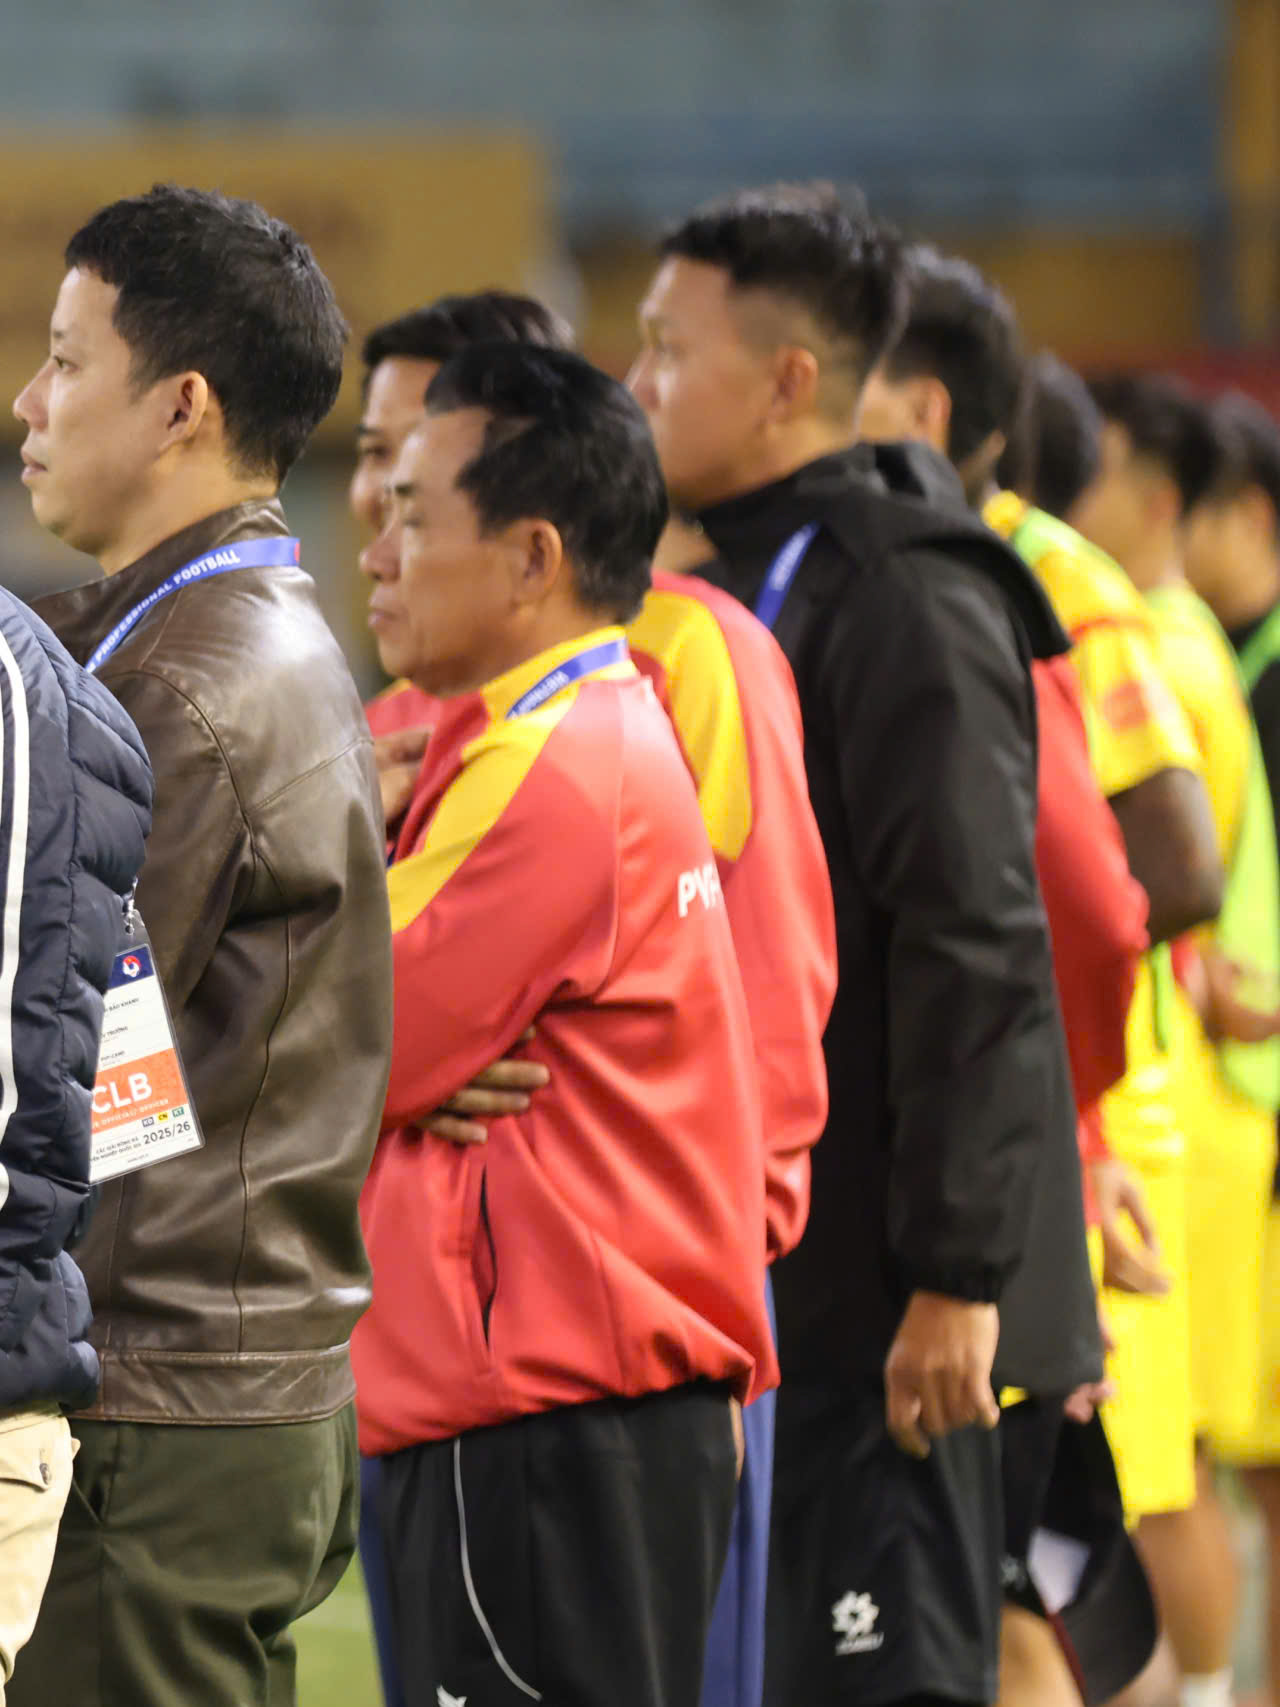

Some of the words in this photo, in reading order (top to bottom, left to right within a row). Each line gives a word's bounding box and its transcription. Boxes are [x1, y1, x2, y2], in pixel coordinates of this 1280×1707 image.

[173, 549, 240, 585] FOOTBALL
[91, 1072, 152, 1113] CLB
[143, 1121, 191, 1144] 2025/26
